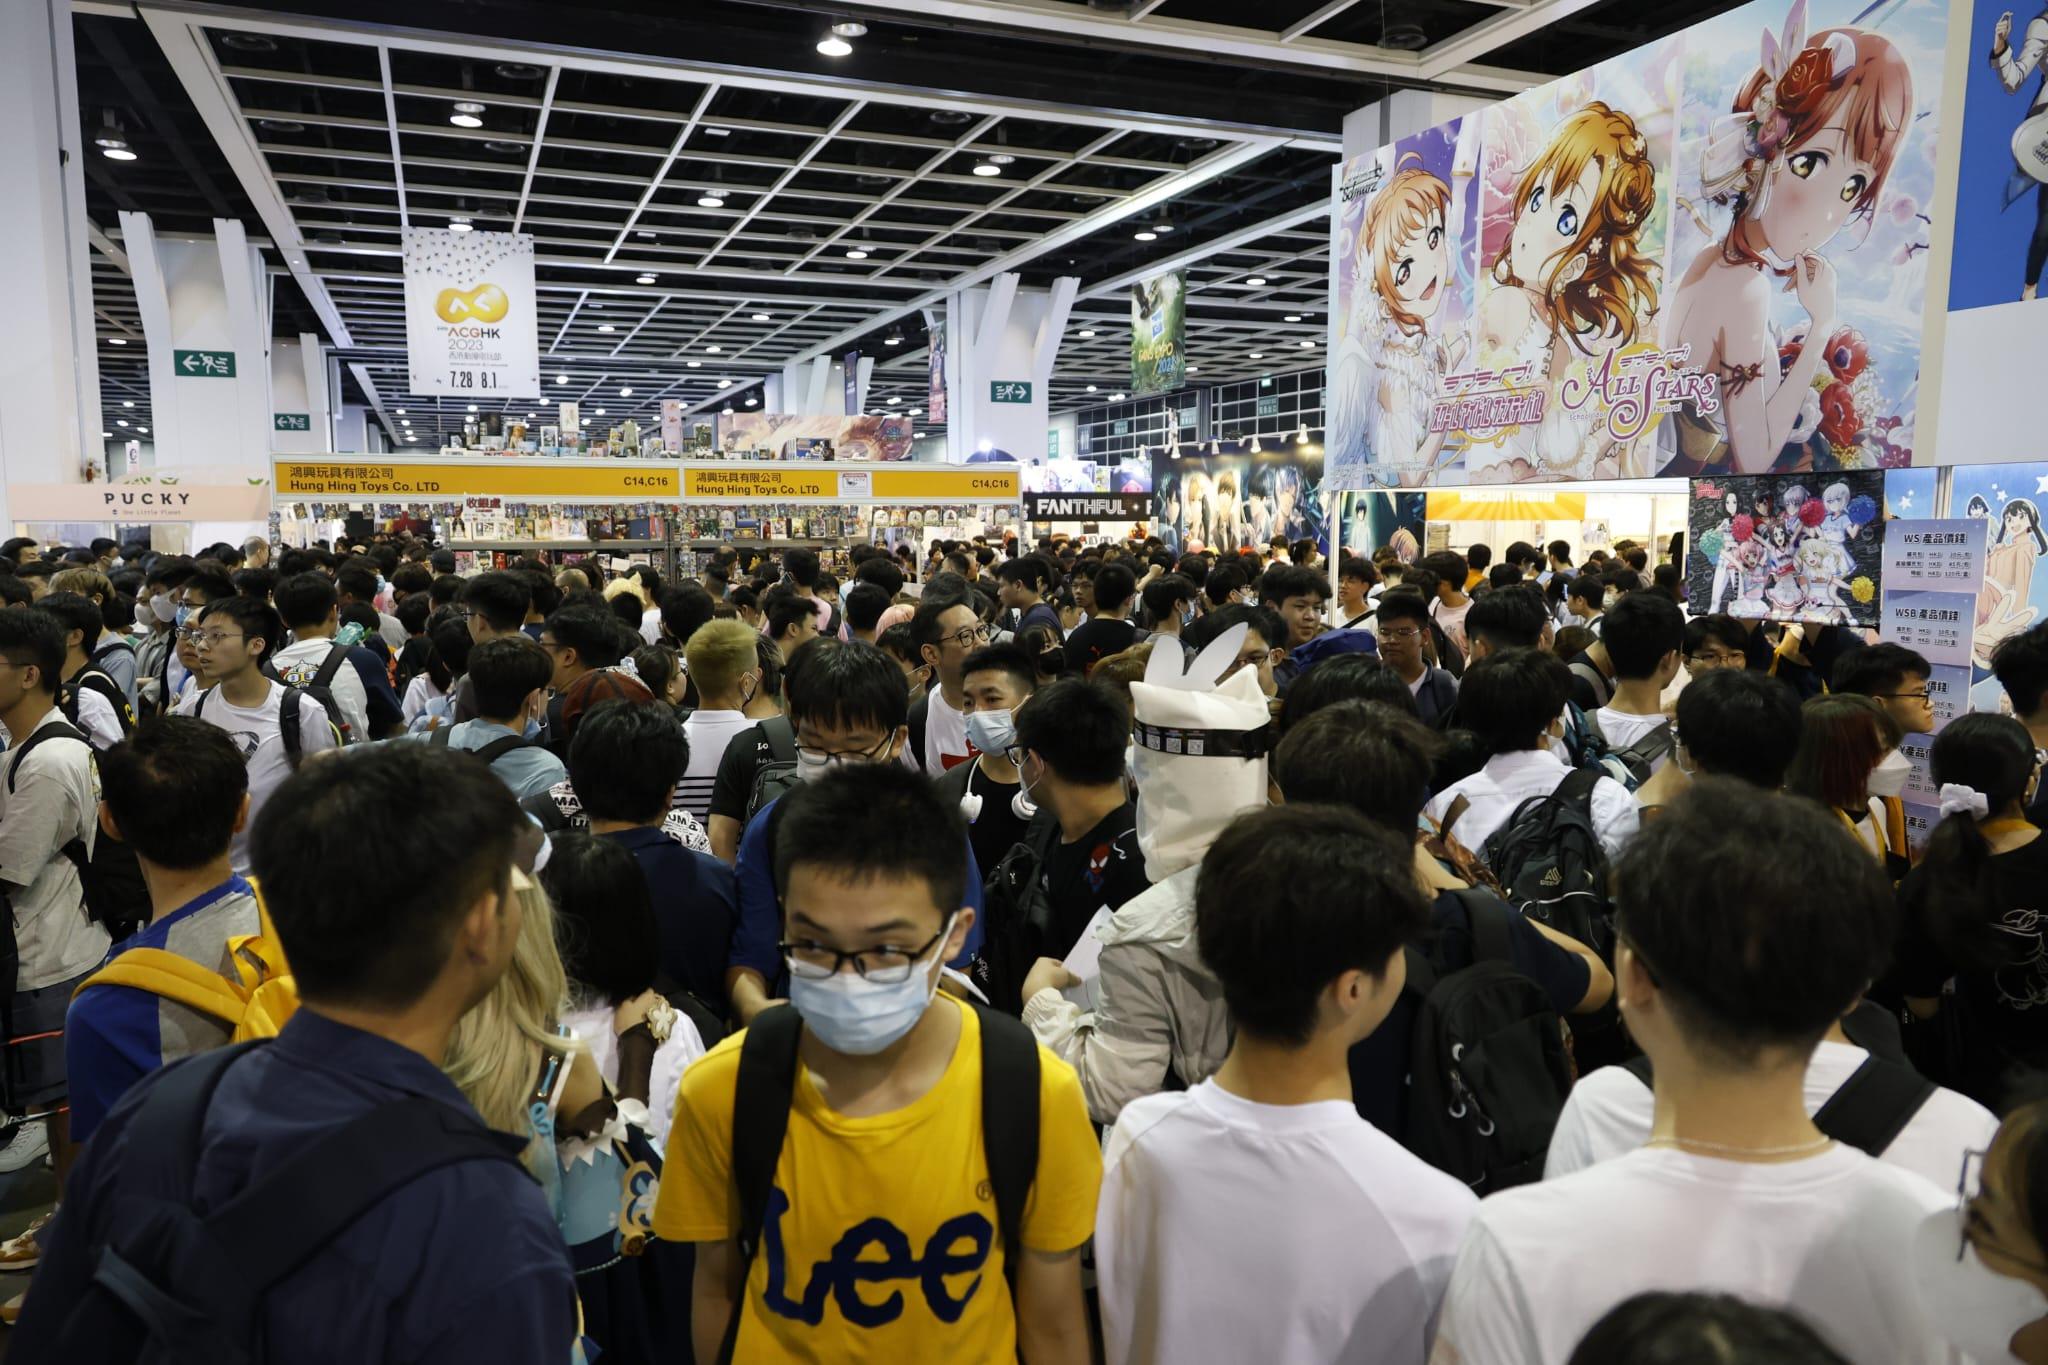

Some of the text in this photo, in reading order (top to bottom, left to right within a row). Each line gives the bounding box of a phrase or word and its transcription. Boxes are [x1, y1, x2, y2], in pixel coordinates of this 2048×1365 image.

[448, 327, 501, 339] ACGHK
[449, 338, 484, 350] 2023
[450, 371, 497, 389] 7.28 8.1
[290, 466, 393, 479] 鴻興玩具有限公司
[696, 471, 781, 483] 鴻興玩具有限公司
[290, 480, 440, 493] Hung Hing Toys Co. LTD
[624, 476, 668, 487] C14,C16
[972, 479, 1010, 489] C14,C16
[696, 484, 820, 495] Hung Hing Toys Co. LTD
[104, 492, 190, 505] PUCKY
[1904, 534, 1920, 543] WS
[1895, 608, 1917, 617] WSB
[763, 1185, 994, 1328] Lee
